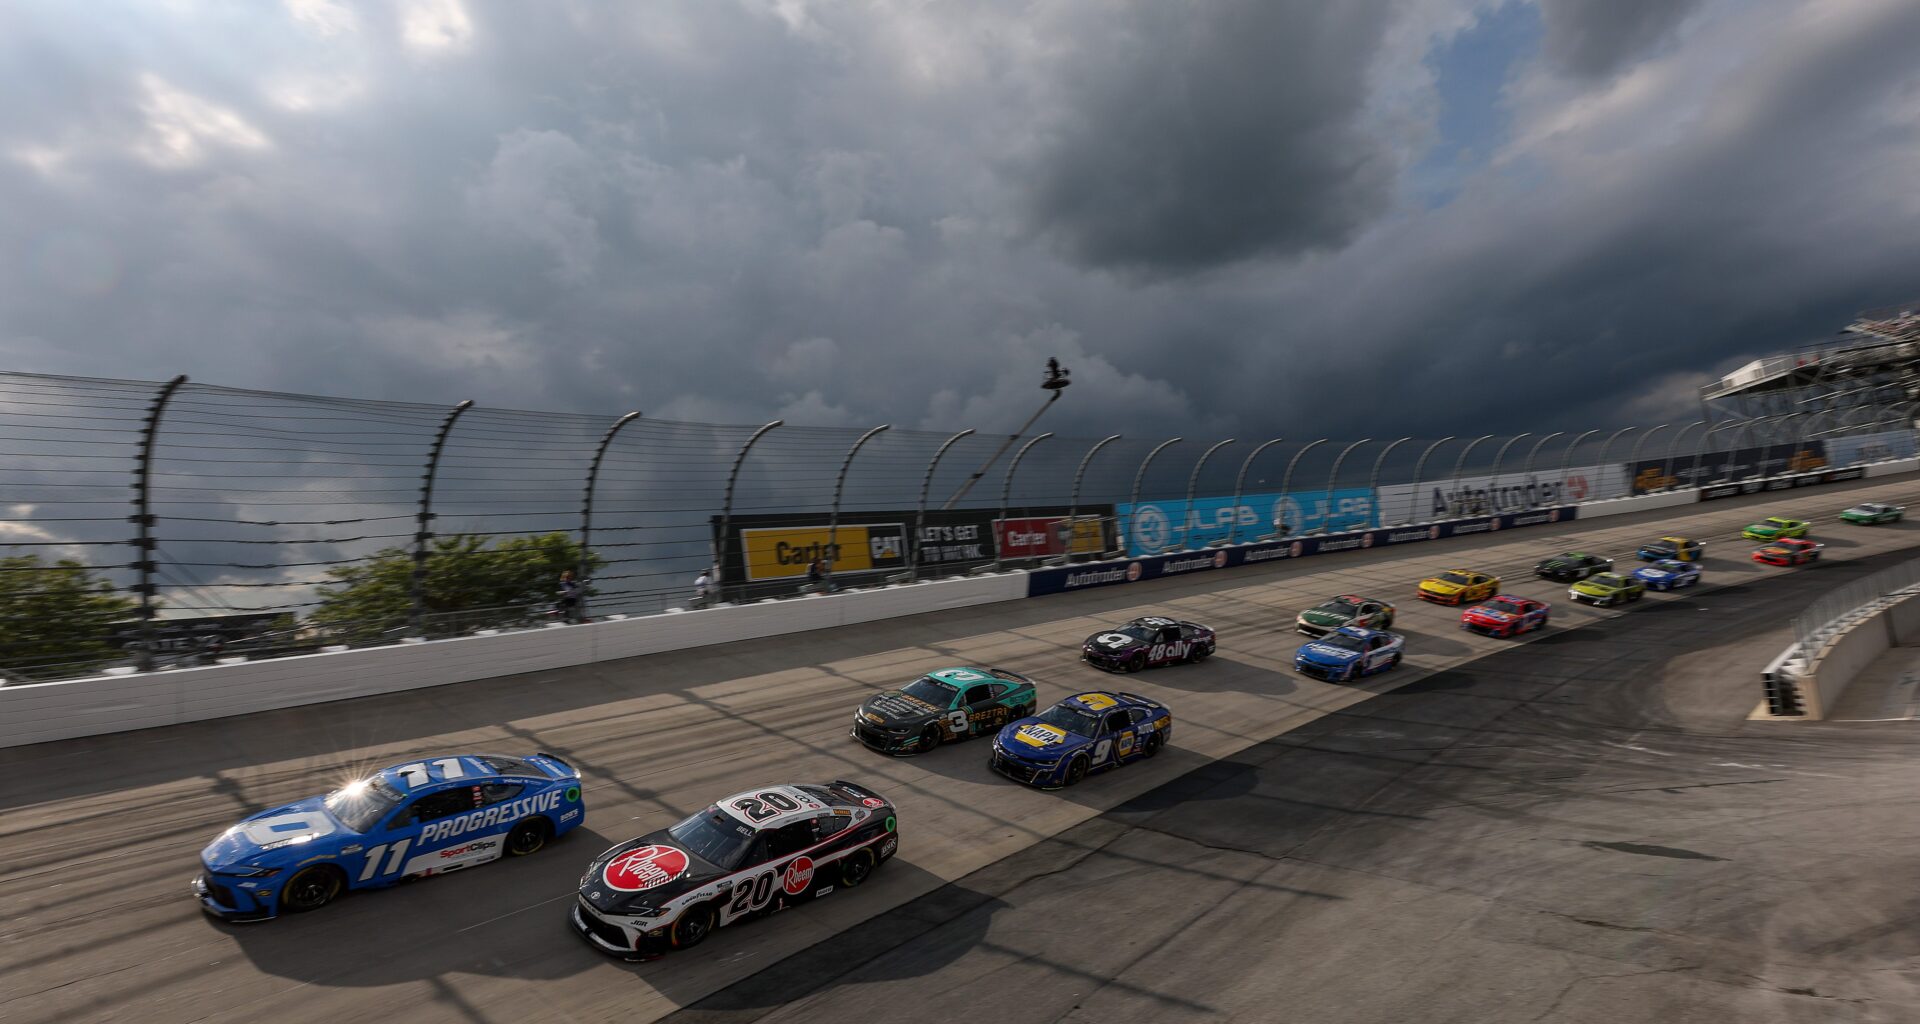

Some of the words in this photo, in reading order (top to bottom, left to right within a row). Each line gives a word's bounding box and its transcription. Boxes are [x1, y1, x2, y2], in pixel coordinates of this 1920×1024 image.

[1007, 531, 1047, 547] Carter
[1147, 643, 1167, 661] 48
[1166, 640, 1192, 660] ally
[947, 710, 969, 733] 3
[1023, 726, 1060, 743] NAPA
[1091, 738, 1113, 765] 9
[399, 757, 465, 788] 11
[416, 788, 562, 847] PROGRESSIVE
[732, 791, 799, 823] 20
[736, 825, 754, 838] BELL
[357, 837, 412, 882] 11
[440, 841, 497, 859] SportClips
[611, 846, 676, 885] Rheem
[785, 860, 815, 890] Rheem
[727, 867, 778, 918] 20
